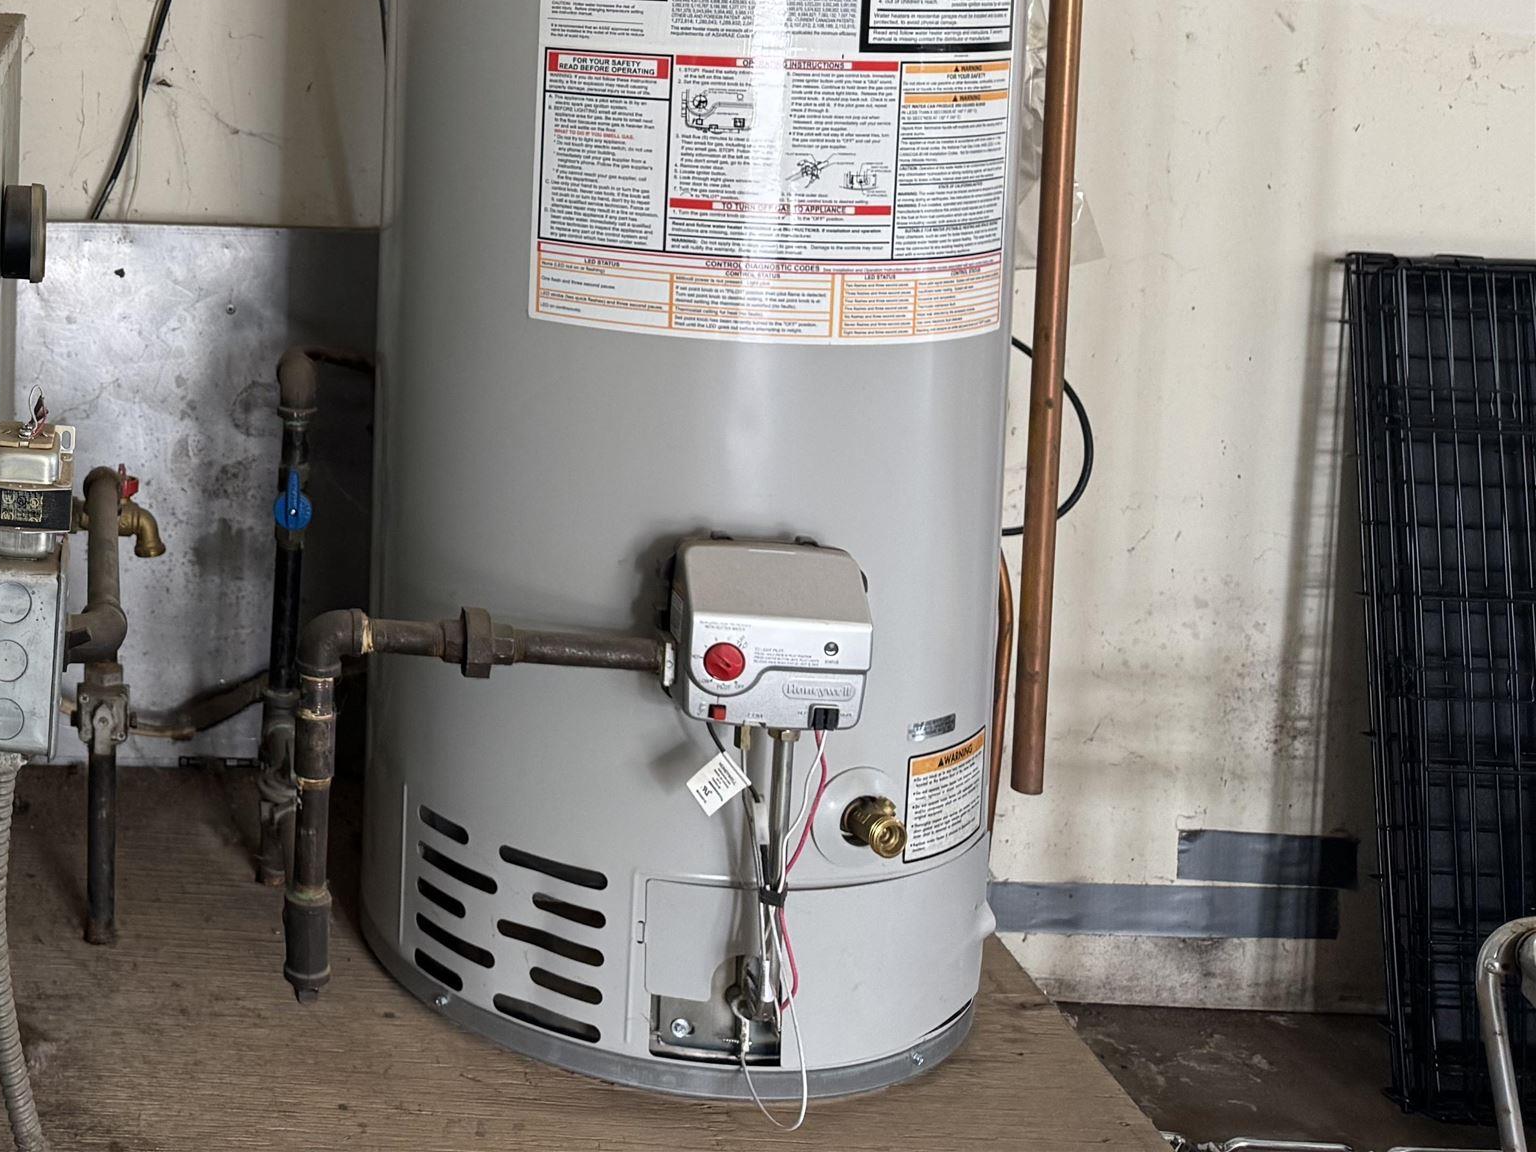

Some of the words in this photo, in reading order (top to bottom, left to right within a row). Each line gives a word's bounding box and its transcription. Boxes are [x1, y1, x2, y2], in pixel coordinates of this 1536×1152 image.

[589, 57, 610, 66] YOUR
[611, 59, 641, 67] SAFETY
[790, 60, 845, 70] INSTRUCTIONS
[960, 64, 983, 72] WARNING
[559, 62, 578, 70] READ
[580, 64, 609, 73] BEFORE
[611, 66, 655, 75] OPERATING
[721, 201, 733, 209] TO
[805, 205, 846, 213] APPLIANCE
[597, 259, 620, 267] STATUS
[705, 260, 742, 269] CONTROL
[793, 264, 820, 272] CODES
[785, 682, 852, 699] Honeywell
[943, 743, 974, 765] WARNING
